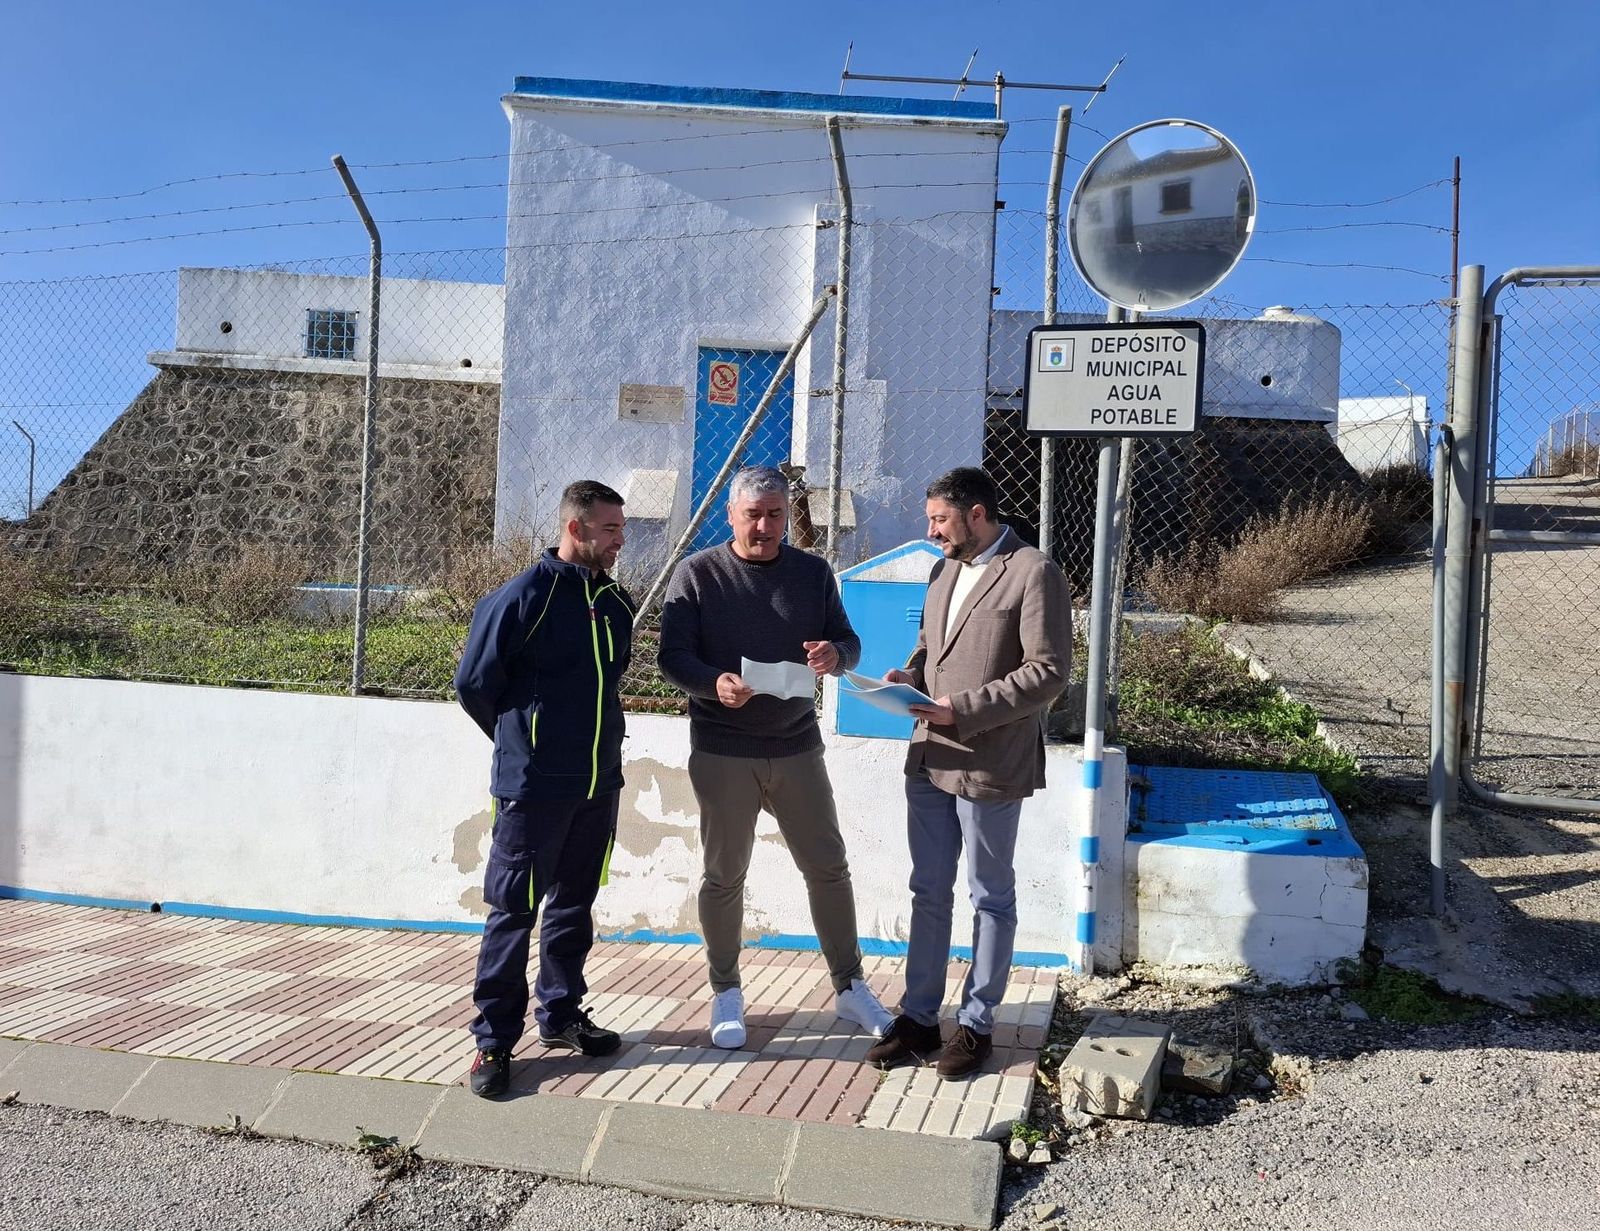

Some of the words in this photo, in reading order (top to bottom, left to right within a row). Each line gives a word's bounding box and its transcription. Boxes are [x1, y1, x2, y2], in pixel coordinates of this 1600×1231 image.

[1091, 333, 1186, 353] DEPÓSITO
[1086, 360, 1187, 377] MUNICIPAL
[1107, 384, 1162, 401] AGUA
[1090, 408, 1177, 425] POTABLE
